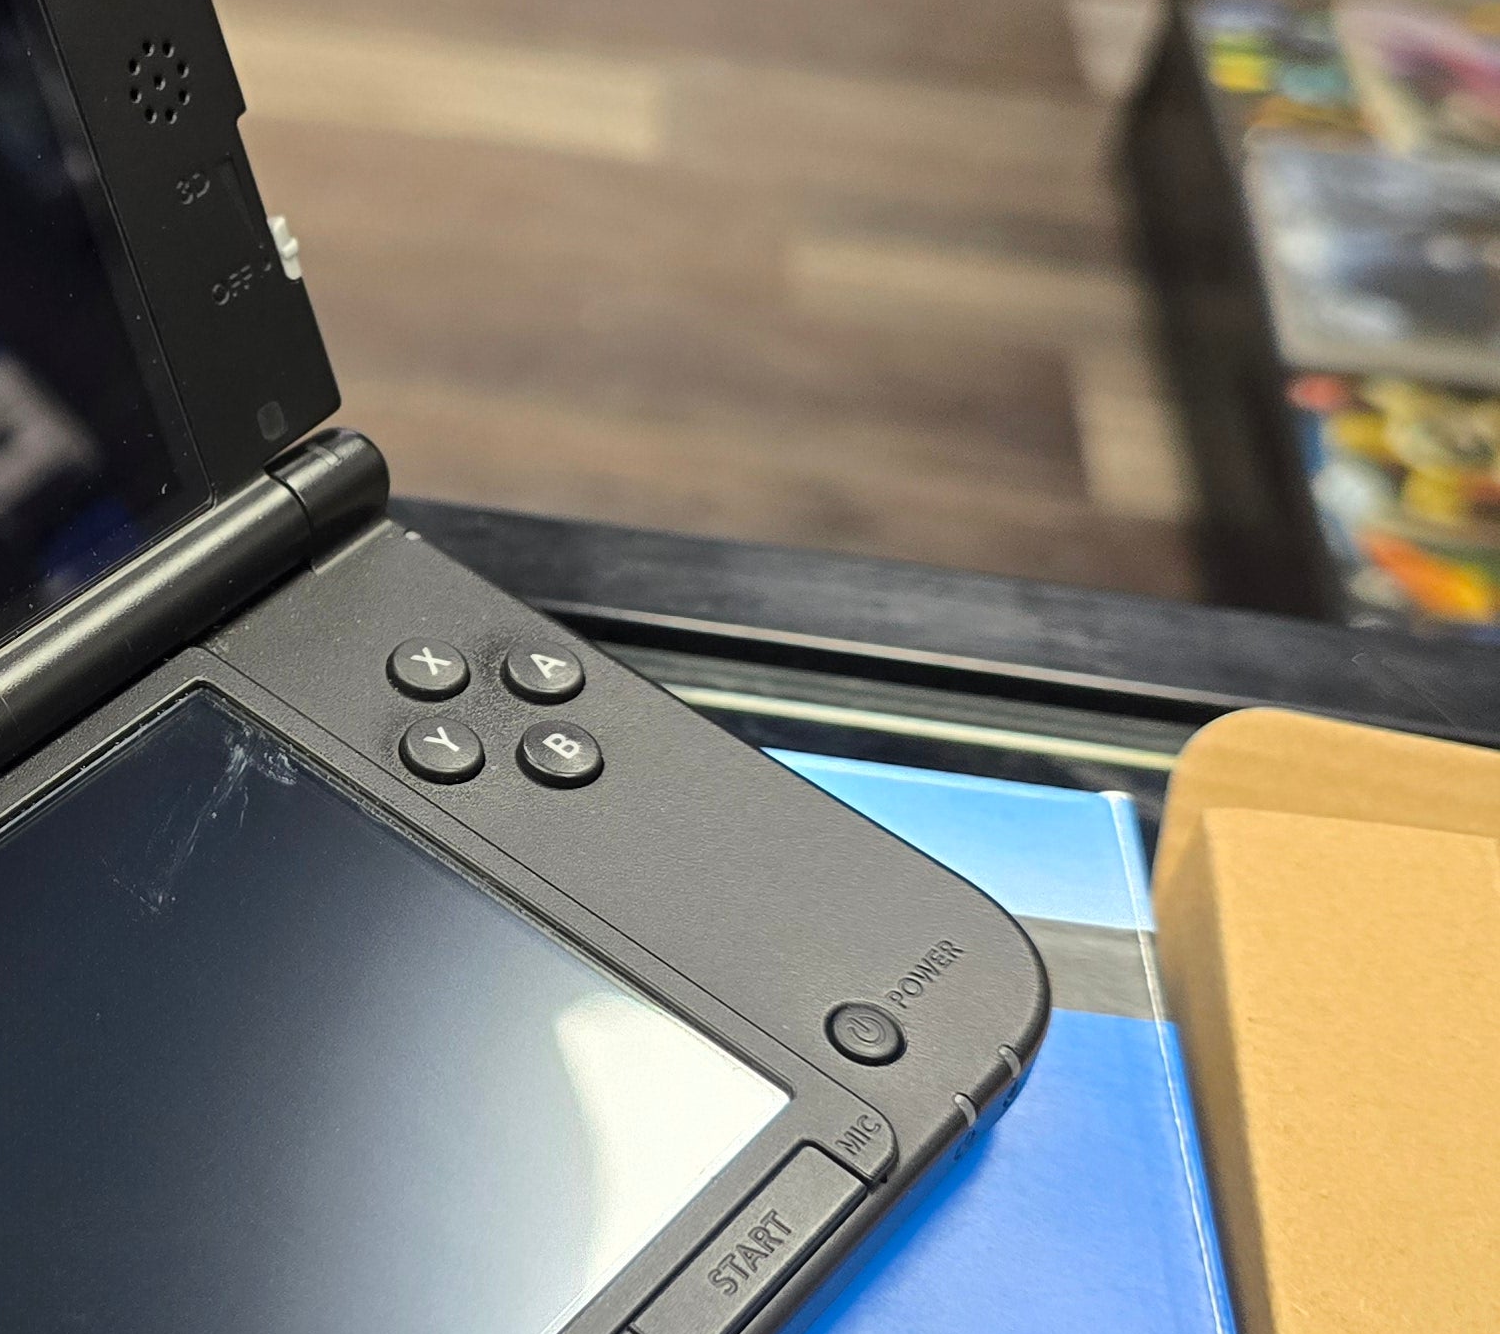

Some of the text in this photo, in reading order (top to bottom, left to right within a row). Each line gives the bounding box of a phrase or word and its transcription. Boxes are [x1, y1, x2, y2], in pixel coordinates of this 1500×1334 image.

[176, 172, 210, 205] 3D
[212, 264, 252, 306] OFF
[410, 646, 452, 676] X
[530, 653, 567, 679] A
[423, 726, 460, 752] Y
[542, 733, 583, 759] B
[886, 939, 965, 1010] POWER
[835, 1113, 882, 1156] MIC
[708, 1208, 792, 1298] START
